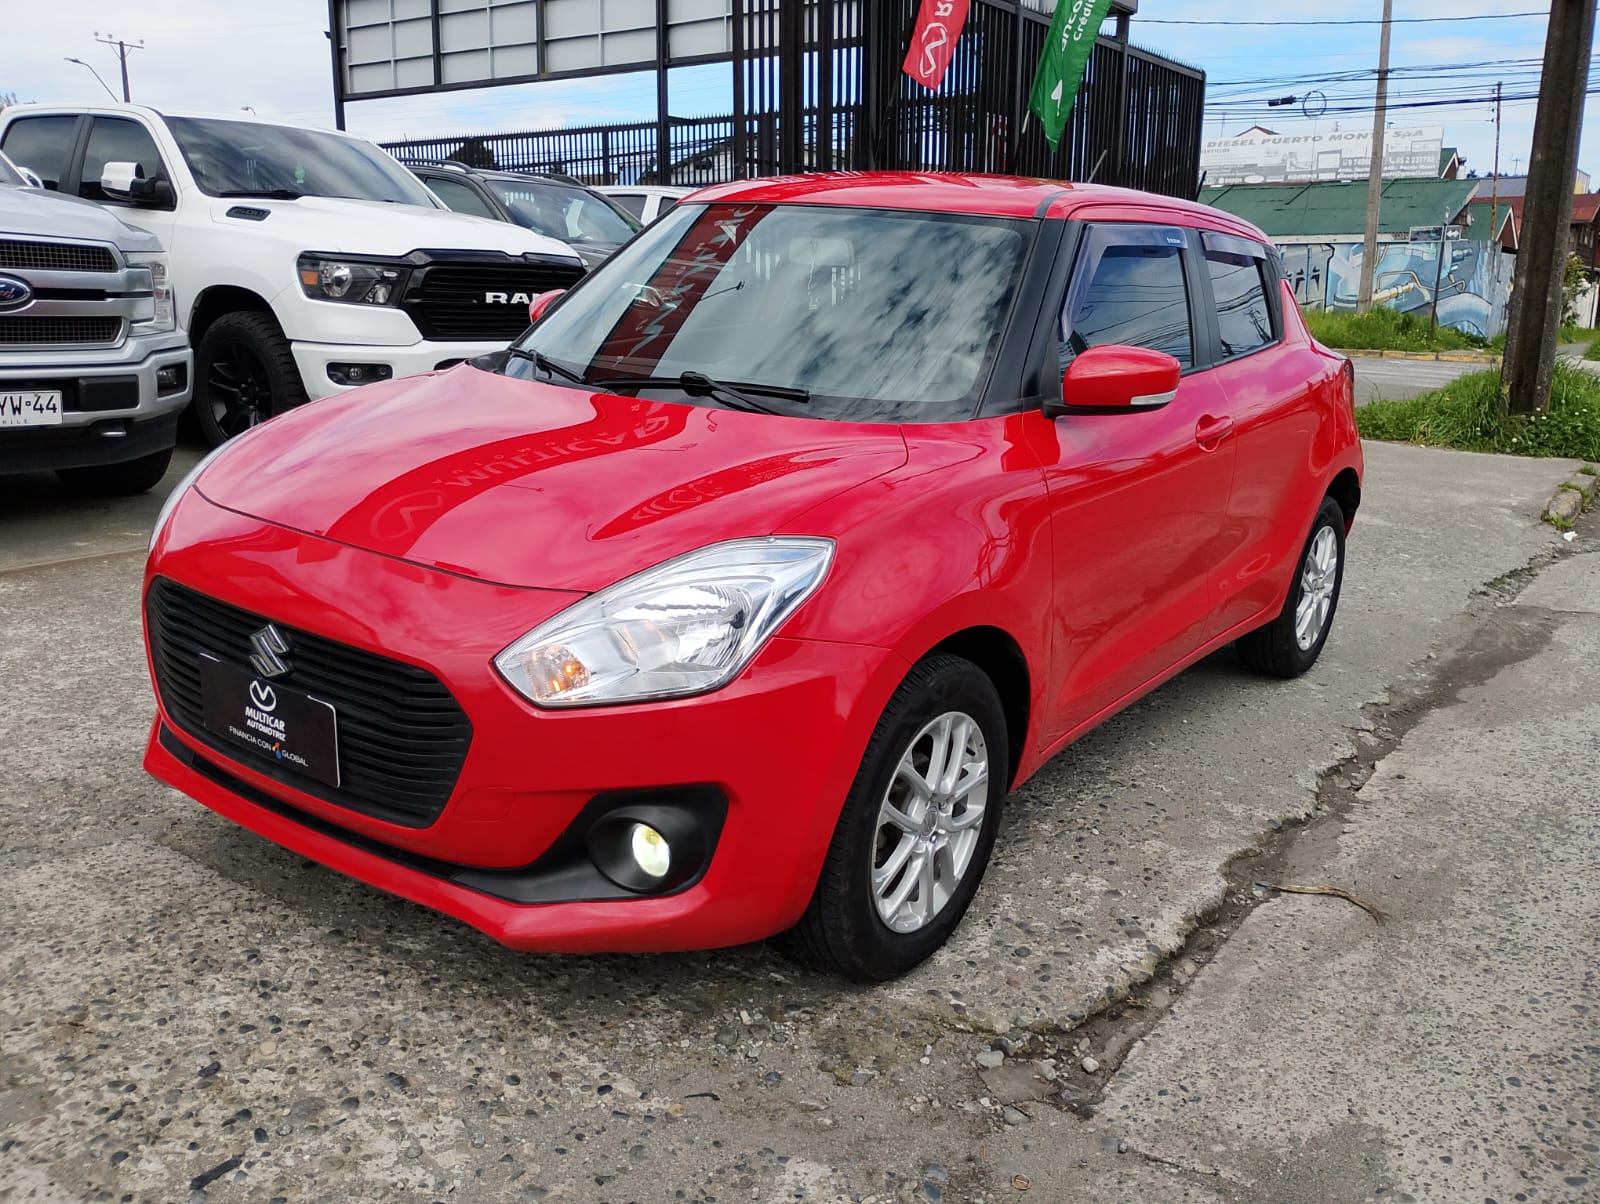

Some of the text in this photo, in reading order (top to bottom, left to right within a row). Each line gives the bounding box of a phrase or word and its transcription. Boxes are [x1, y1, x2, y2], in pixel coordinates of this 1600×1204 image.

[1206, 139, 1257, 148] DIESEL
[1260, 135, 1323, 145] PUERTO
[1392, 129, 1424, 140] SpA
[244, 706, 286, 732] MULTICAR
[246, 718, 287, 742] AUTOMOTRIZ
[228, 725, 309, 767] FINANCIA CON GLOBAL
